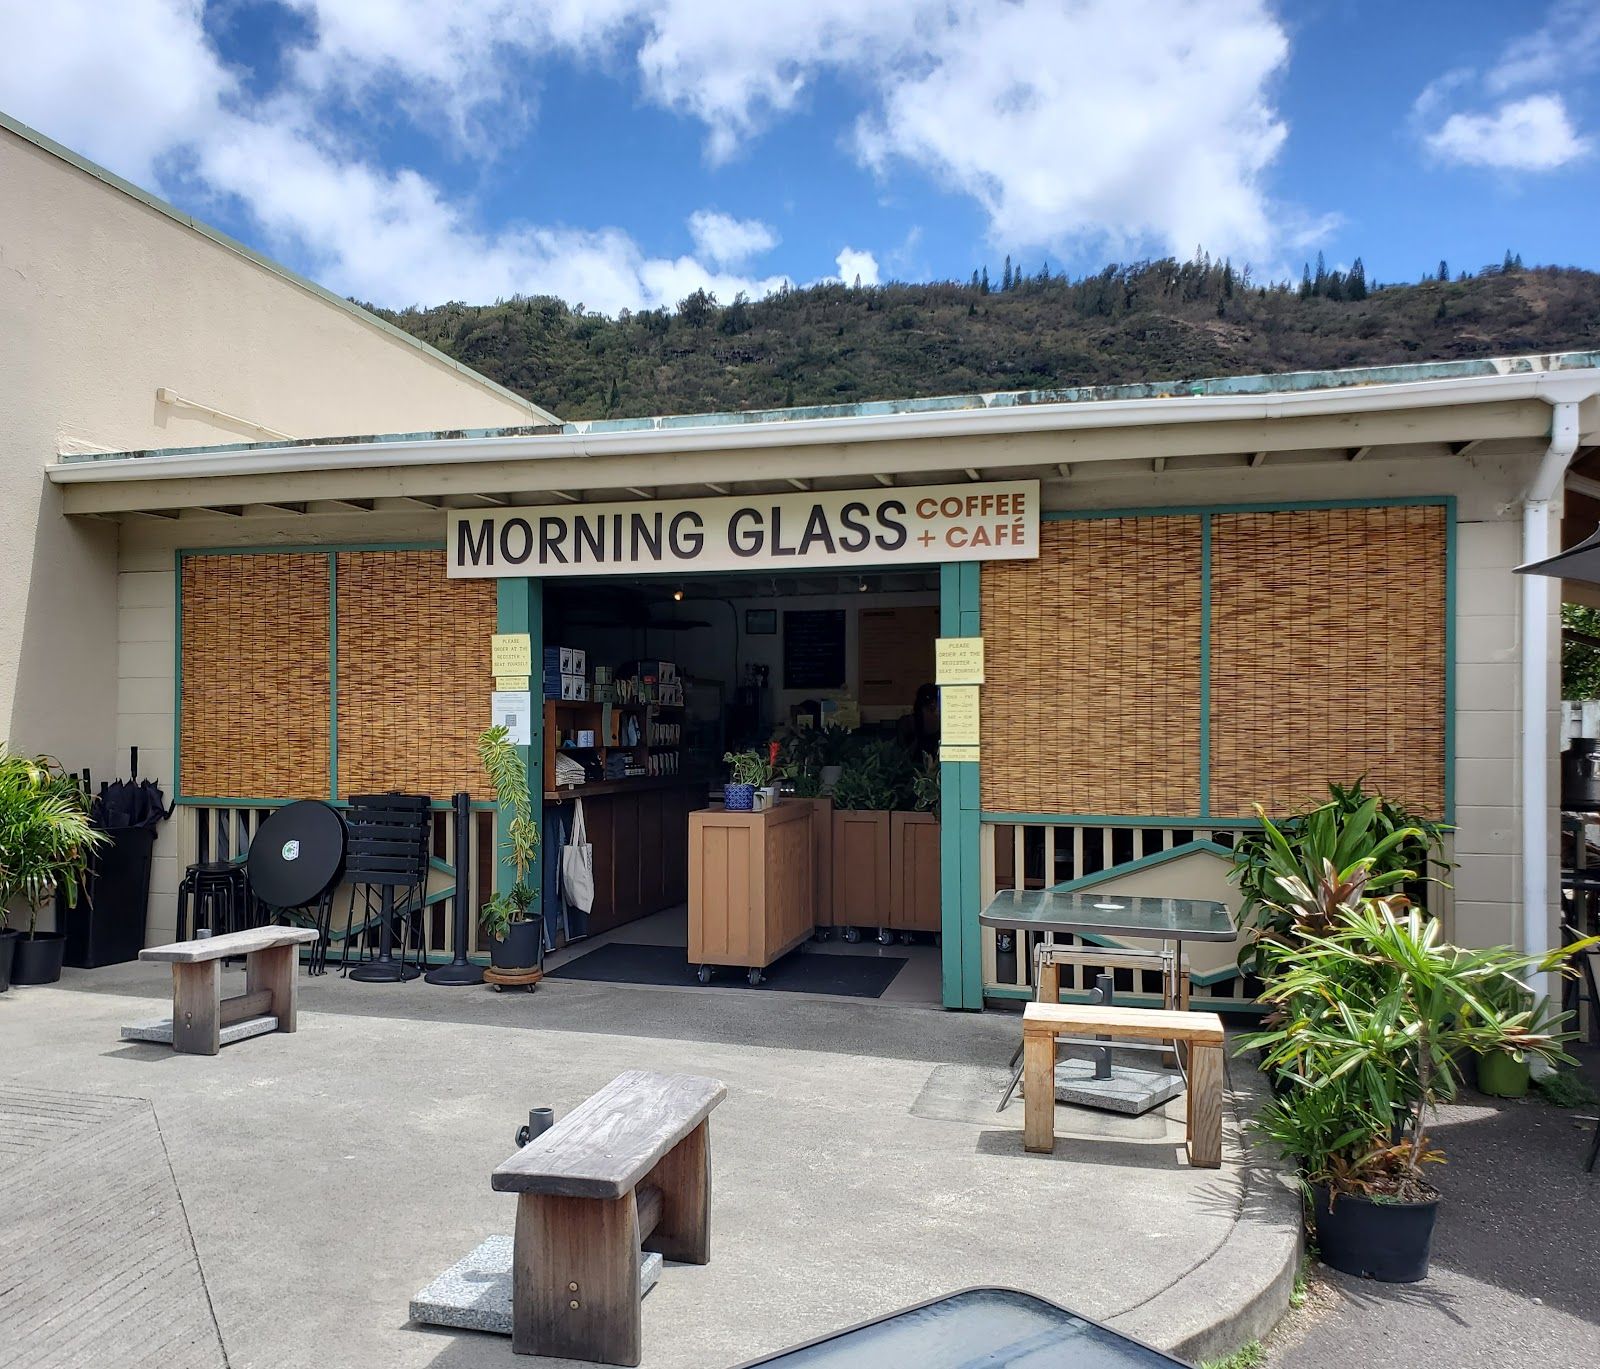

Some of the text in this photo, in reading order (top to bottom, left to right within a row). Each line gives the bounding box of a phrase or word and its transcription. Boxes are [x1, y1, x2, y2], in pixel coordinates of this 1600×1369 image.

[916, 494, 1024, 519] COFFEE
[458, 500, 908, 566] MORNING GLASS
[918, 517, 1025, 548] + CAFÉ
